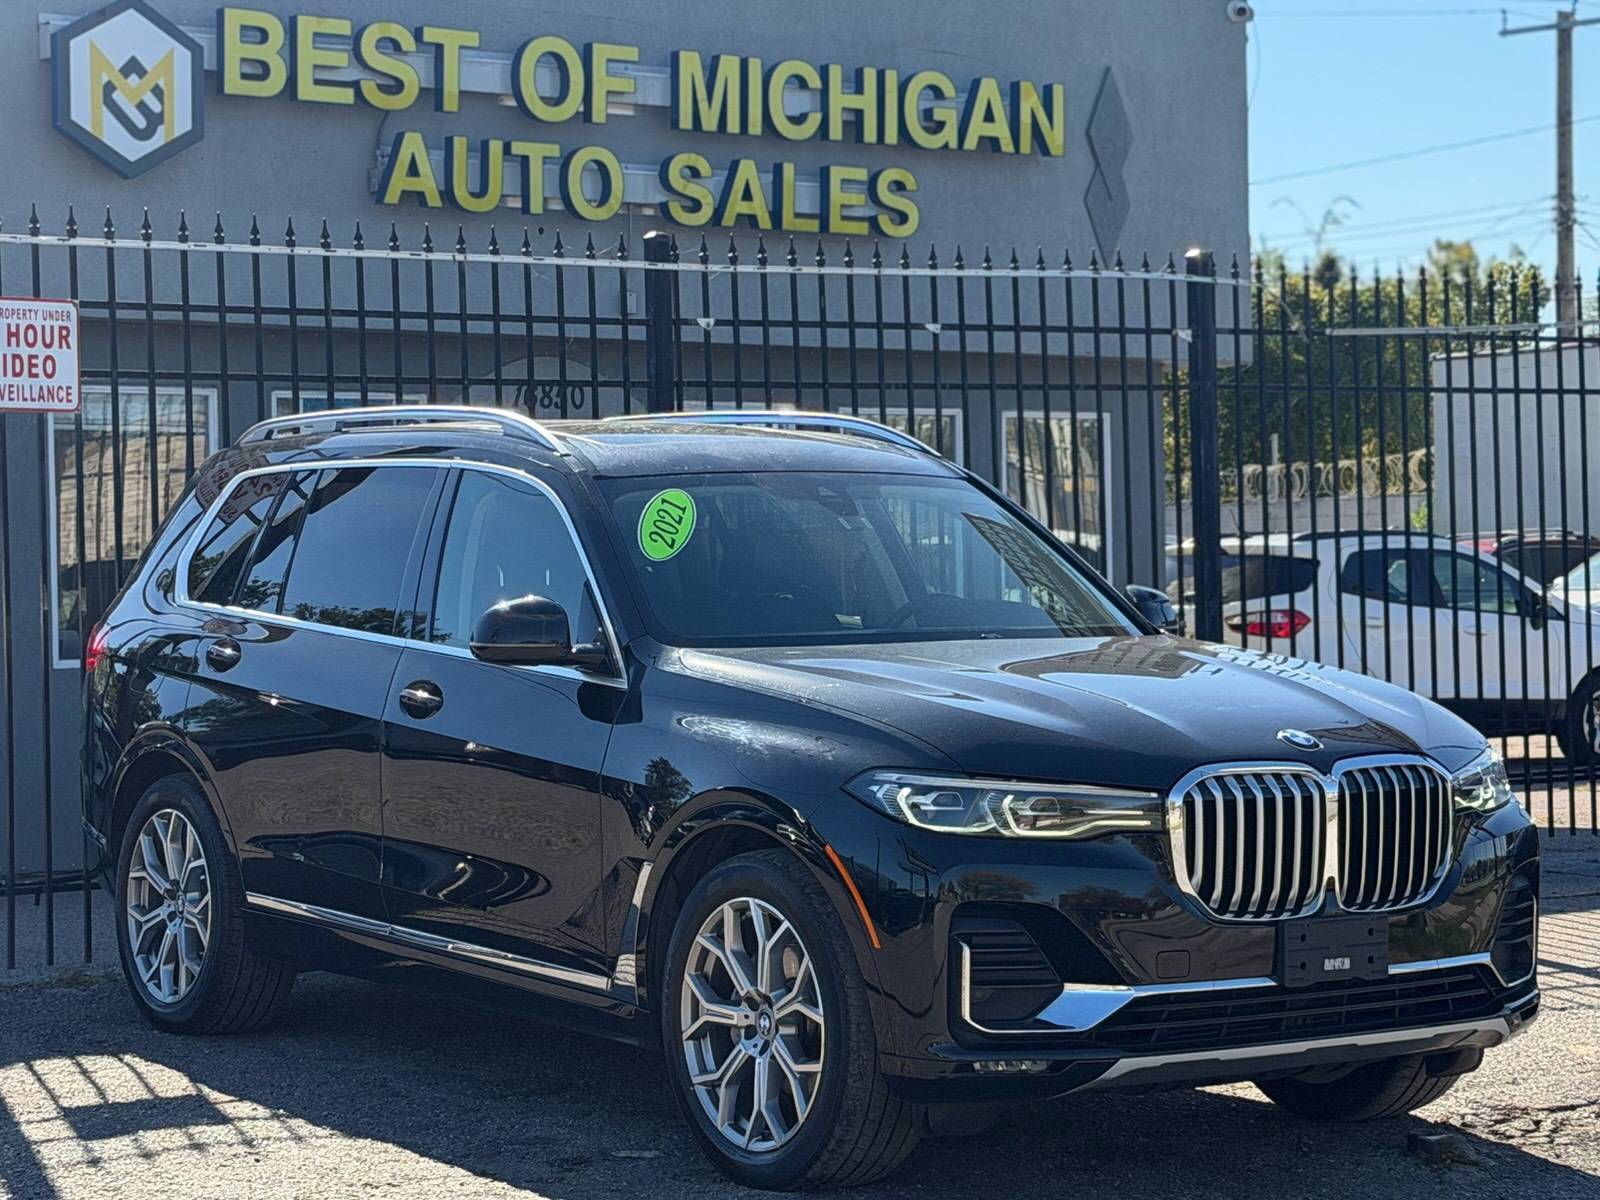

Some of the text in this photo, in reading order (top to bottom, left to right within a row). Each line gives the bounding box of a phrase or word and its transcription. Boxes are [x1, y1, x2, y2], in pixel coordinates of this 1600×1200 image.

[222, 8, 1065, 157] BEST OF MICHIGAN
[383, 131, 920, 238] AUTO SALES
[42, 309, 72, 322] UNDER
[6, 322, 72, 350] HOUR
[2, 353, 57, 380] IDEO
[648, 498, 687, 550] 2021
